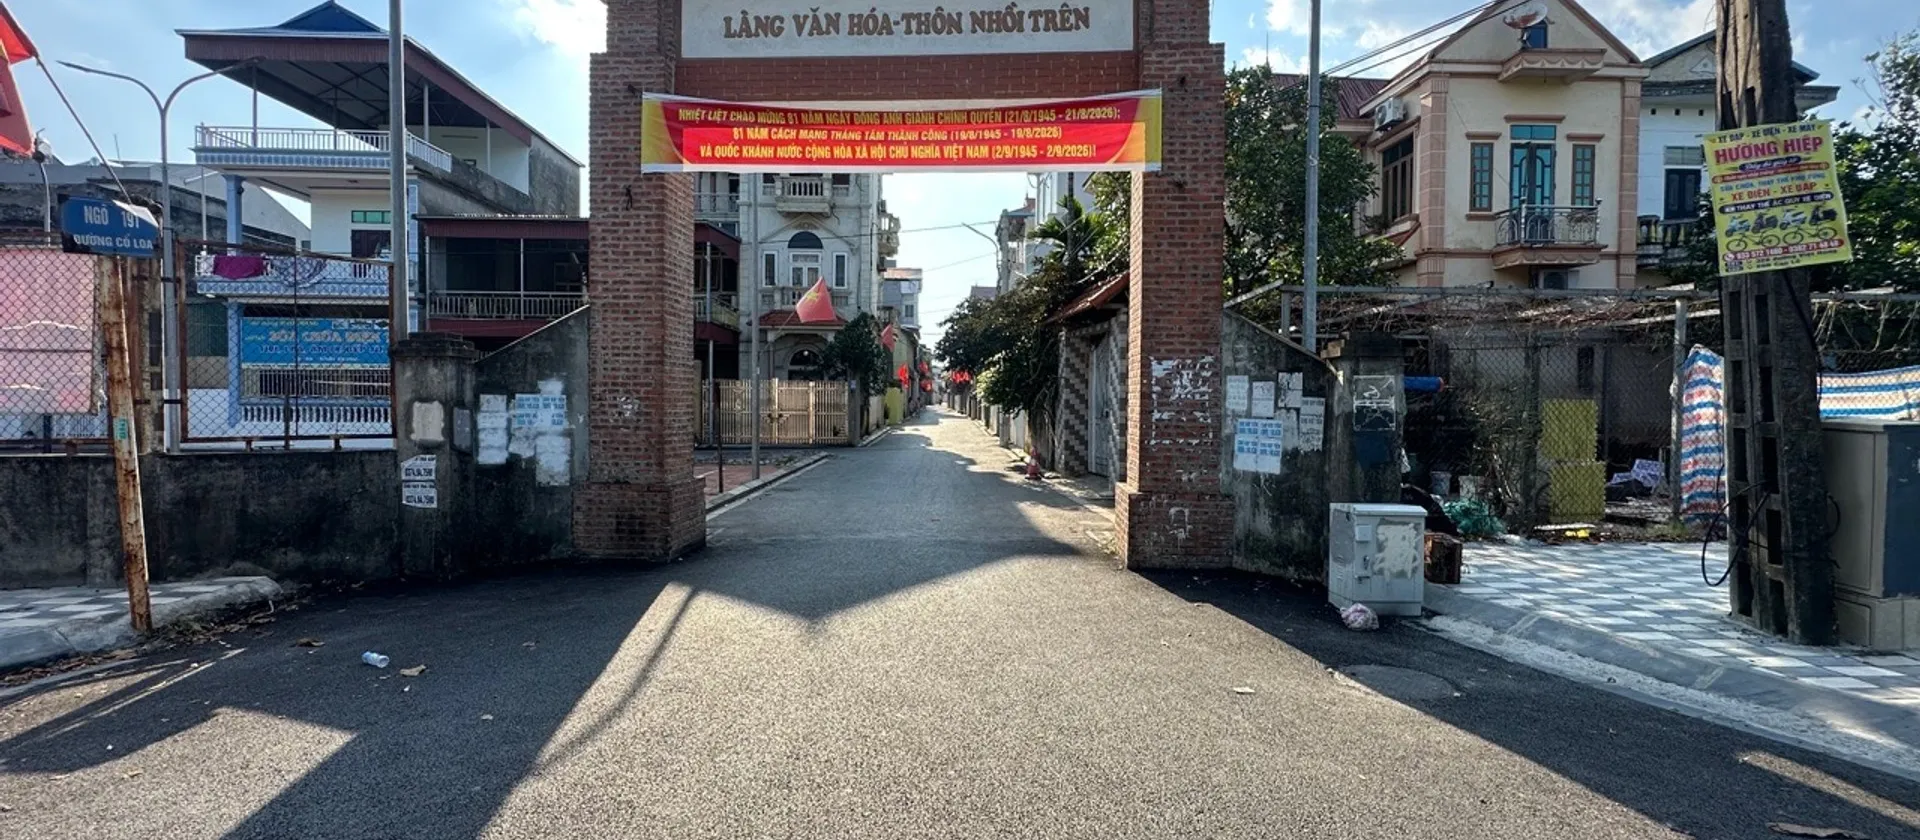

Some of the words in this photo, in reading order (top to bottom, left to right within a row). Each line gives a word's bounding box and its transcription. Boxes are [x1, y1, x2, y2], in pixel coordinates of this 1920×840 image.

[723, 10, 785, 38] LÀNG
[792, 6, 841, 37] VĂN
[969, 1, 1025, 34] NHỒI
[1028, 2, 1090, 33] TRÊN
[679, 108, 705, 125] NHIỆT
[708, 110, 727, 125] LIỆT
[730, 110, 756, 124] CHÀO
[788, 112, 799, 124] 81
[803, 110, 824, 125] NĂM
[883, 112, 901, 125] ANH
[1005, 109, 1056, 125] (21/8/1945
[733, 127, 744, 140] 81
[749, 126, 769, 140] NĂM
[770, 126, 796, 140] CÁCH
[798, 130, 828, 143] MẠNG
[830, 129, 862, 142] THÁNG
[864, 130, 885, 142] TÁM
[887, 129, 919, 142] THÀNH
[921, 128, 948, 142] CÔNG
[950, 129, 1001, 142] (19/8/1945
[1012, 126, 1062, 140] 19/8/2026)
[700, 144, 713, 158] VÀ
[714, 142, 740, 159] QUỐC
[742, 143, 774, 159] KHÁNH
[776, 142, 803, 159] NƯỚC
[805, 143, 831, 161] CỘNG
[833, 143, 853, 159] HÒA
[854, 142, 869, 159] XÃ
[871, 144, 887, 161] HỘI
[889, 141, 909, 159] CHỦ
[911, 143, 940, 159] NGHĨA
[943, 143, 964, 161] VIỆT
[966, 145, 990, 159] NAM
[992, 144, 1038, 160] (2/9/1945
[1046, 144, 1097, 158] 2/9/2026)!
[84, 204, 109, 226] NGÕ
[121, 210, 140, 229] 191
[116, 232, 131, 249] CỔ
[133, 238, 154, 250] LOA
